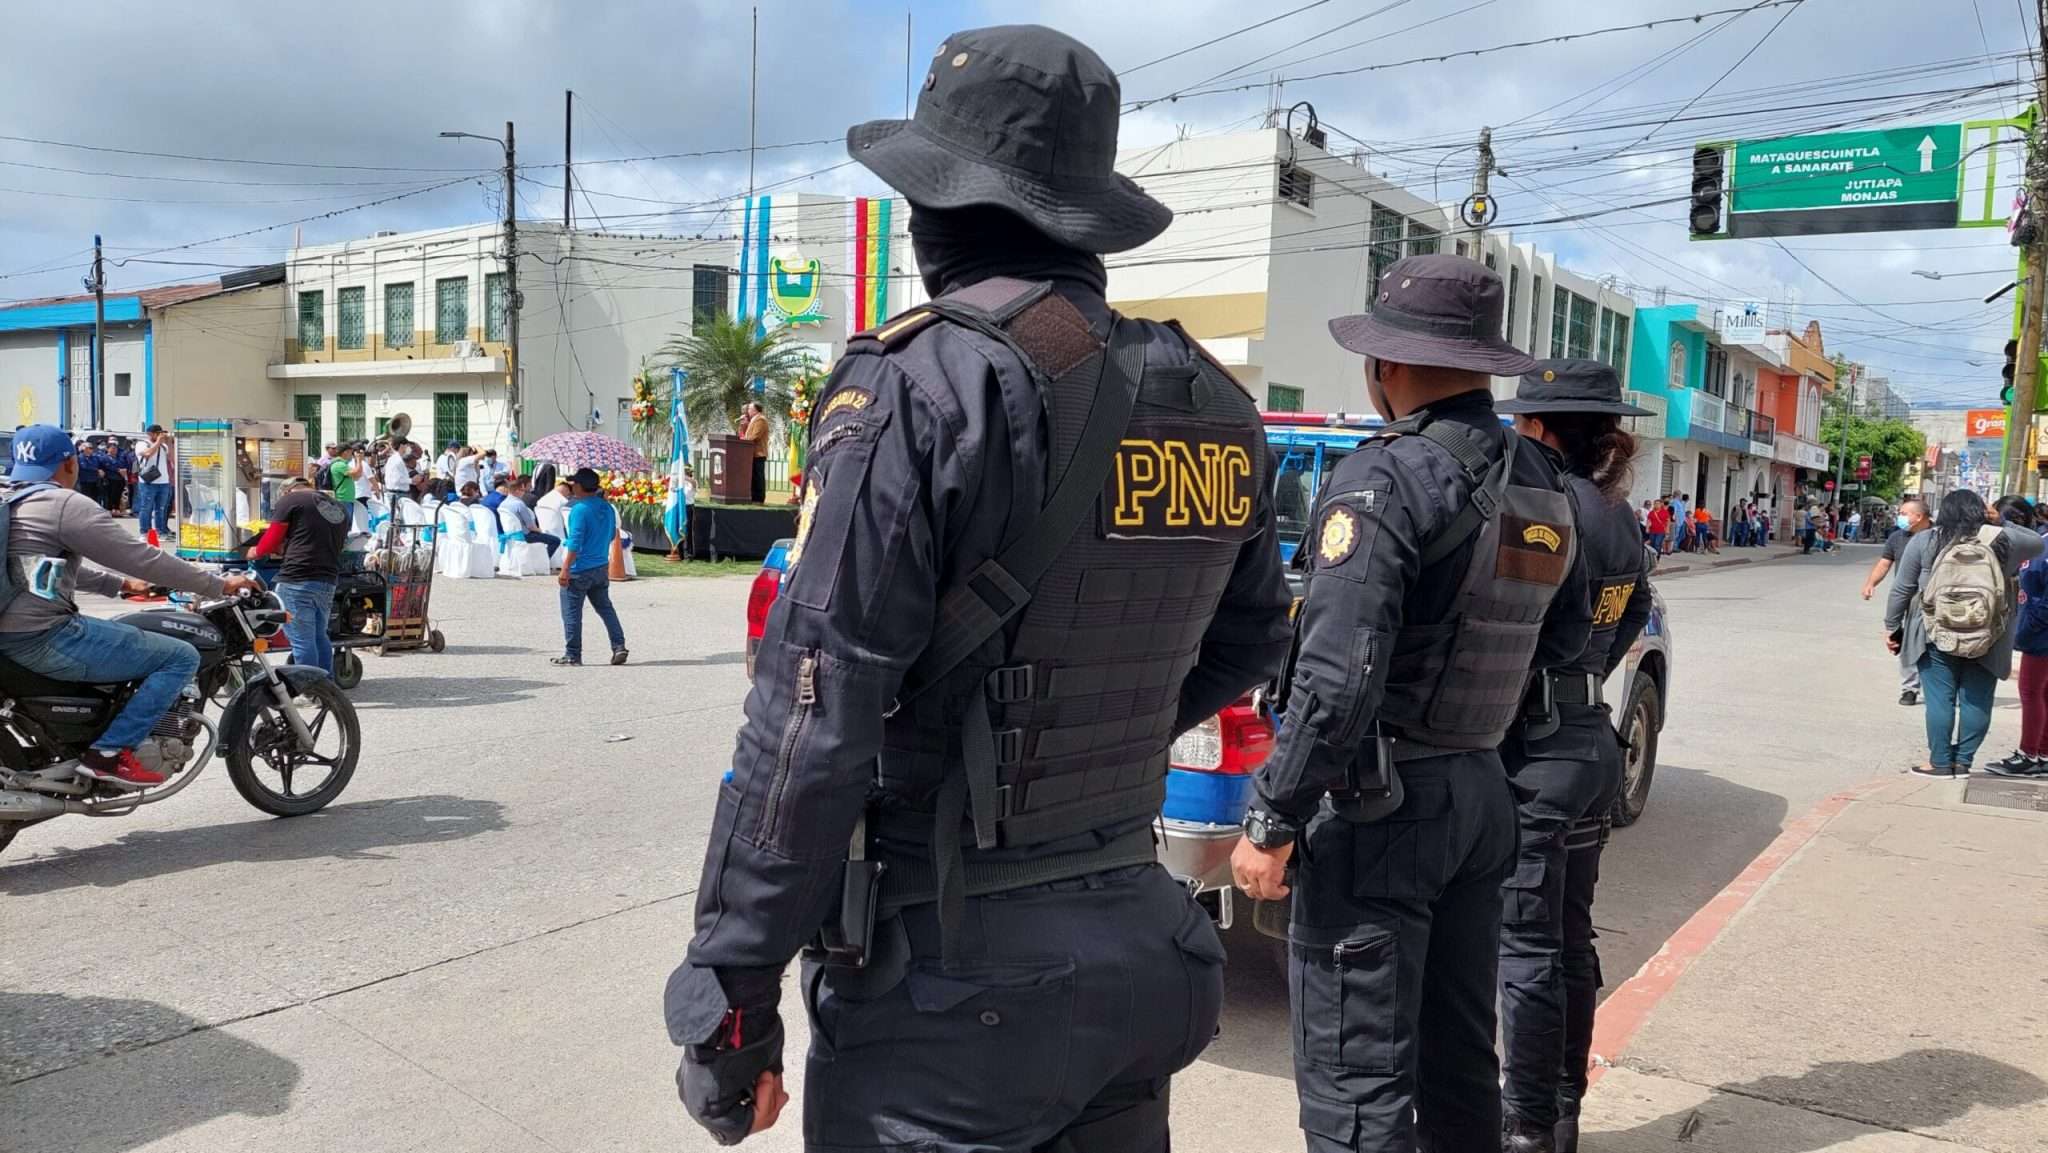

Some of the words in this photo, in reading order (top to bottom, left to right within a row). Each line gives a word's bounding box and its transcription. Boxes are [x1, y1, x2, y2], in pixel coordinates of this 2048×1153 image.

[1750, 147, 1880, 163] MATAQUESCUINTLA
[1771, 165, 1781, 174] A
[1784, 161, 1854, 173] SANARATE
[1845, 178, 1903, 190] JUTIAPA
[1840, 190, 1898, 202] MONJAS
[1115, 439, 1251, 526] PNC
[1592, 582, 1636, 624] PN
[161, 620, 218, 641] SUZUKI
